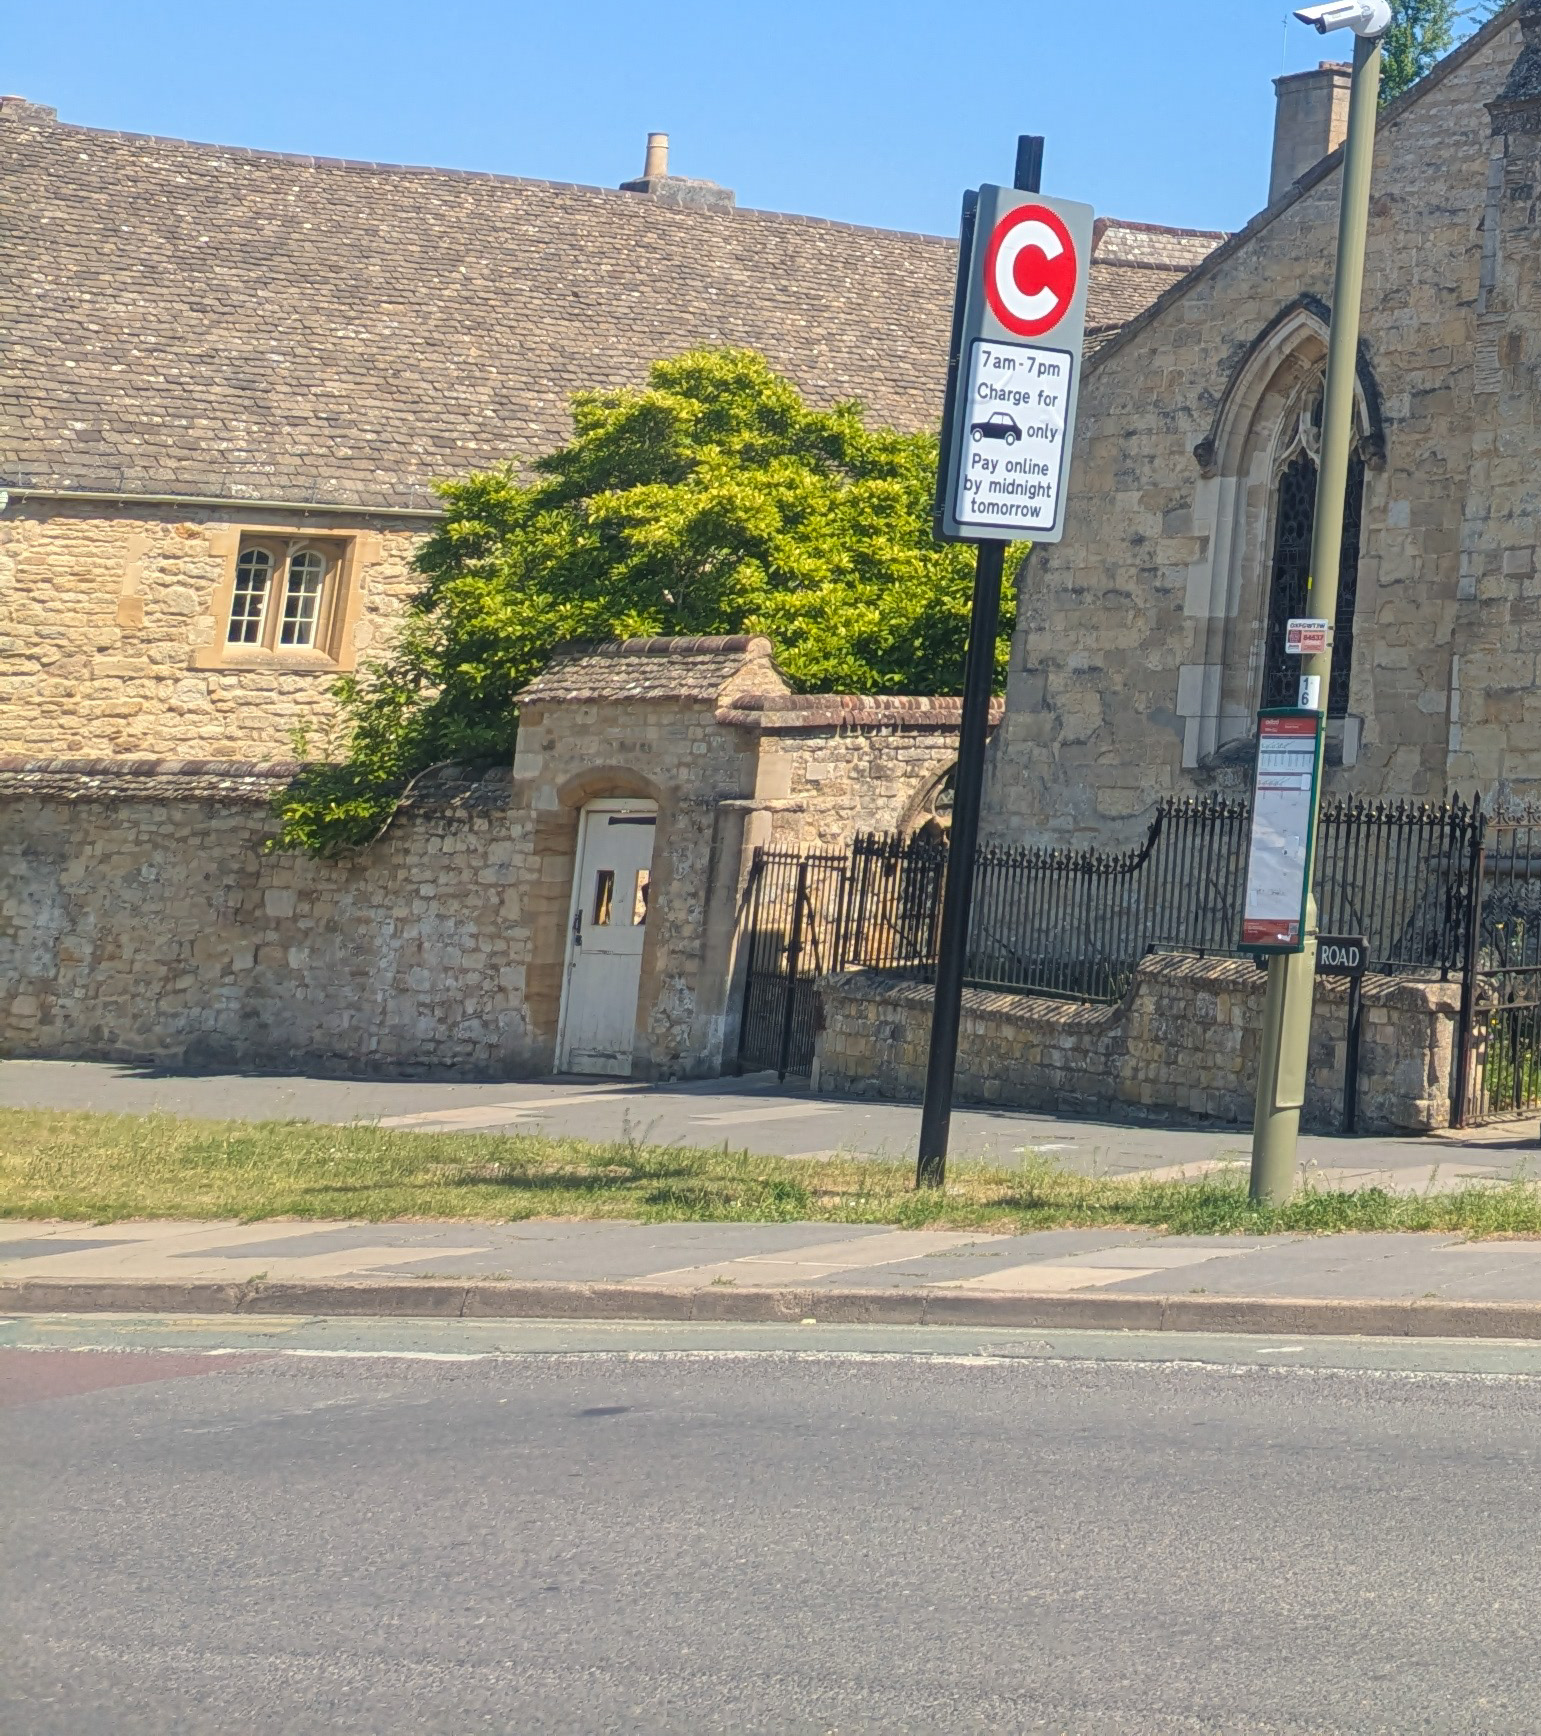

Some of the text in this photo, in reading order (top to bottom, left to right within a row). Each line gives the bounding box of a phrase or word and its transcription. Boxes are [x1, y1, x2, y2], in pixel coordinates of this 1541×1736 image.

[995, 220, 1064, 321] C
[977, 382, 1058, 407] Charge for
[1027, 423, 1058, 443] only
[971, 453, 1049, 476] Pay online
[963, 474, 1052, 500] by midnight
[971, 497, 1042, 518] tomorrow
[1303, 677, 1309, 691] 1
[1301, 692, 1309, 706] 6
[1321, 945, 1360, 967] ROAD
